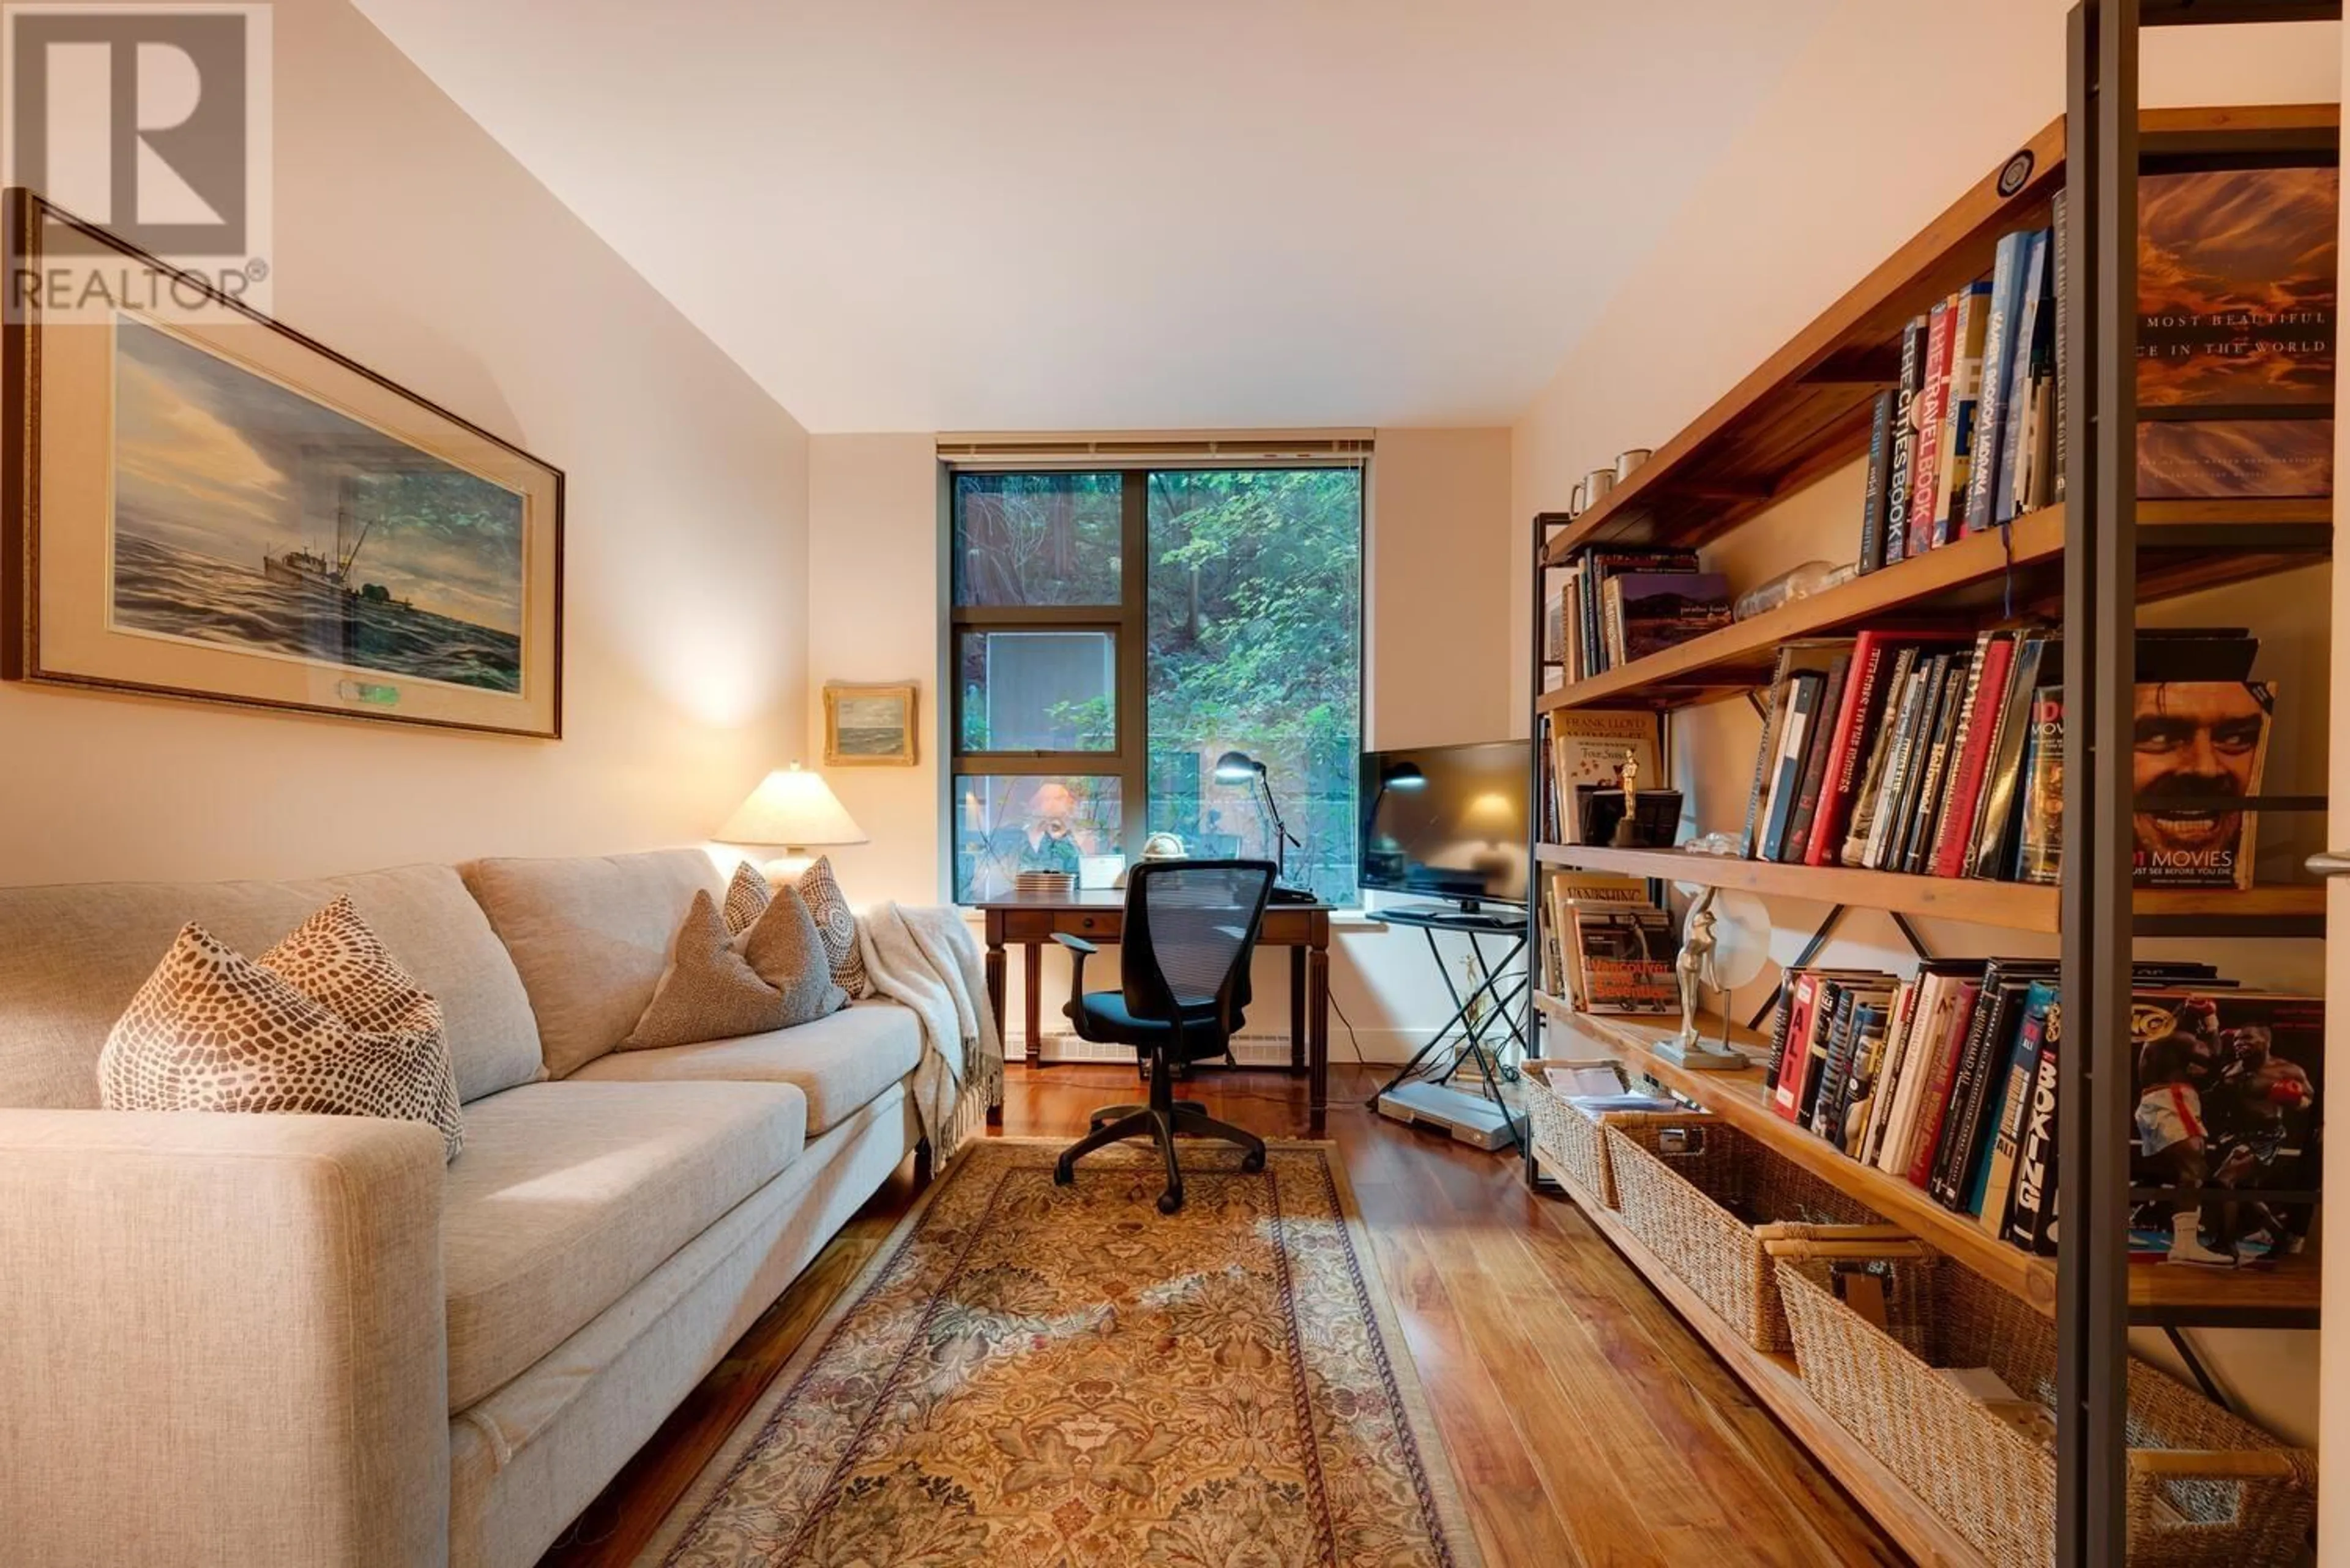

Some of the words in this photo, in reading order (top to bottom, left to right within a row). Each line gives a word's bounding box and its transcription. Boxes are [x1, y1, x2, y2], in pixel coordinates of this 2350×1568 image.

[1927, 320, 1947, 366] THE
[2147, 316, 2199, 327] MOST
[2212, 313, 2325, 326] BEAUTIFUL
[1899, 334, 1917, 384] THE
[2171, 345, 2191, 356] IN
[2205, 343, 2244, 354] THE
[2256, 341, 2325, 353] WORLD
[1892, 389, 1912, 468] CITIES
[1918, 367, 1942, 455] TRAVEL
[1887, 469, 1906, 541] BOOK
[1912, 457, 1934, 521] BOOK
[1566, 717, 1605, 728] FRANK
[1608, 717, 1646, 728] LLOYD
[2149, 867, 2163, 876] SEE
[2165, 867, 2195, 876] BEFORE
[2197, 867, 2216, 876] YOU
[2152, 851, 2232, 867] MOVIES
[1592, 960, 1669, 974] Vancouver
[1595, 981, 1668, 999] Seventies
[1786, 1006, 1803, 1083] ALI
[1966, 1008, 1988, 1069] MUHAMMAD
[2019, 1062, 2057, 1213] BOXING
